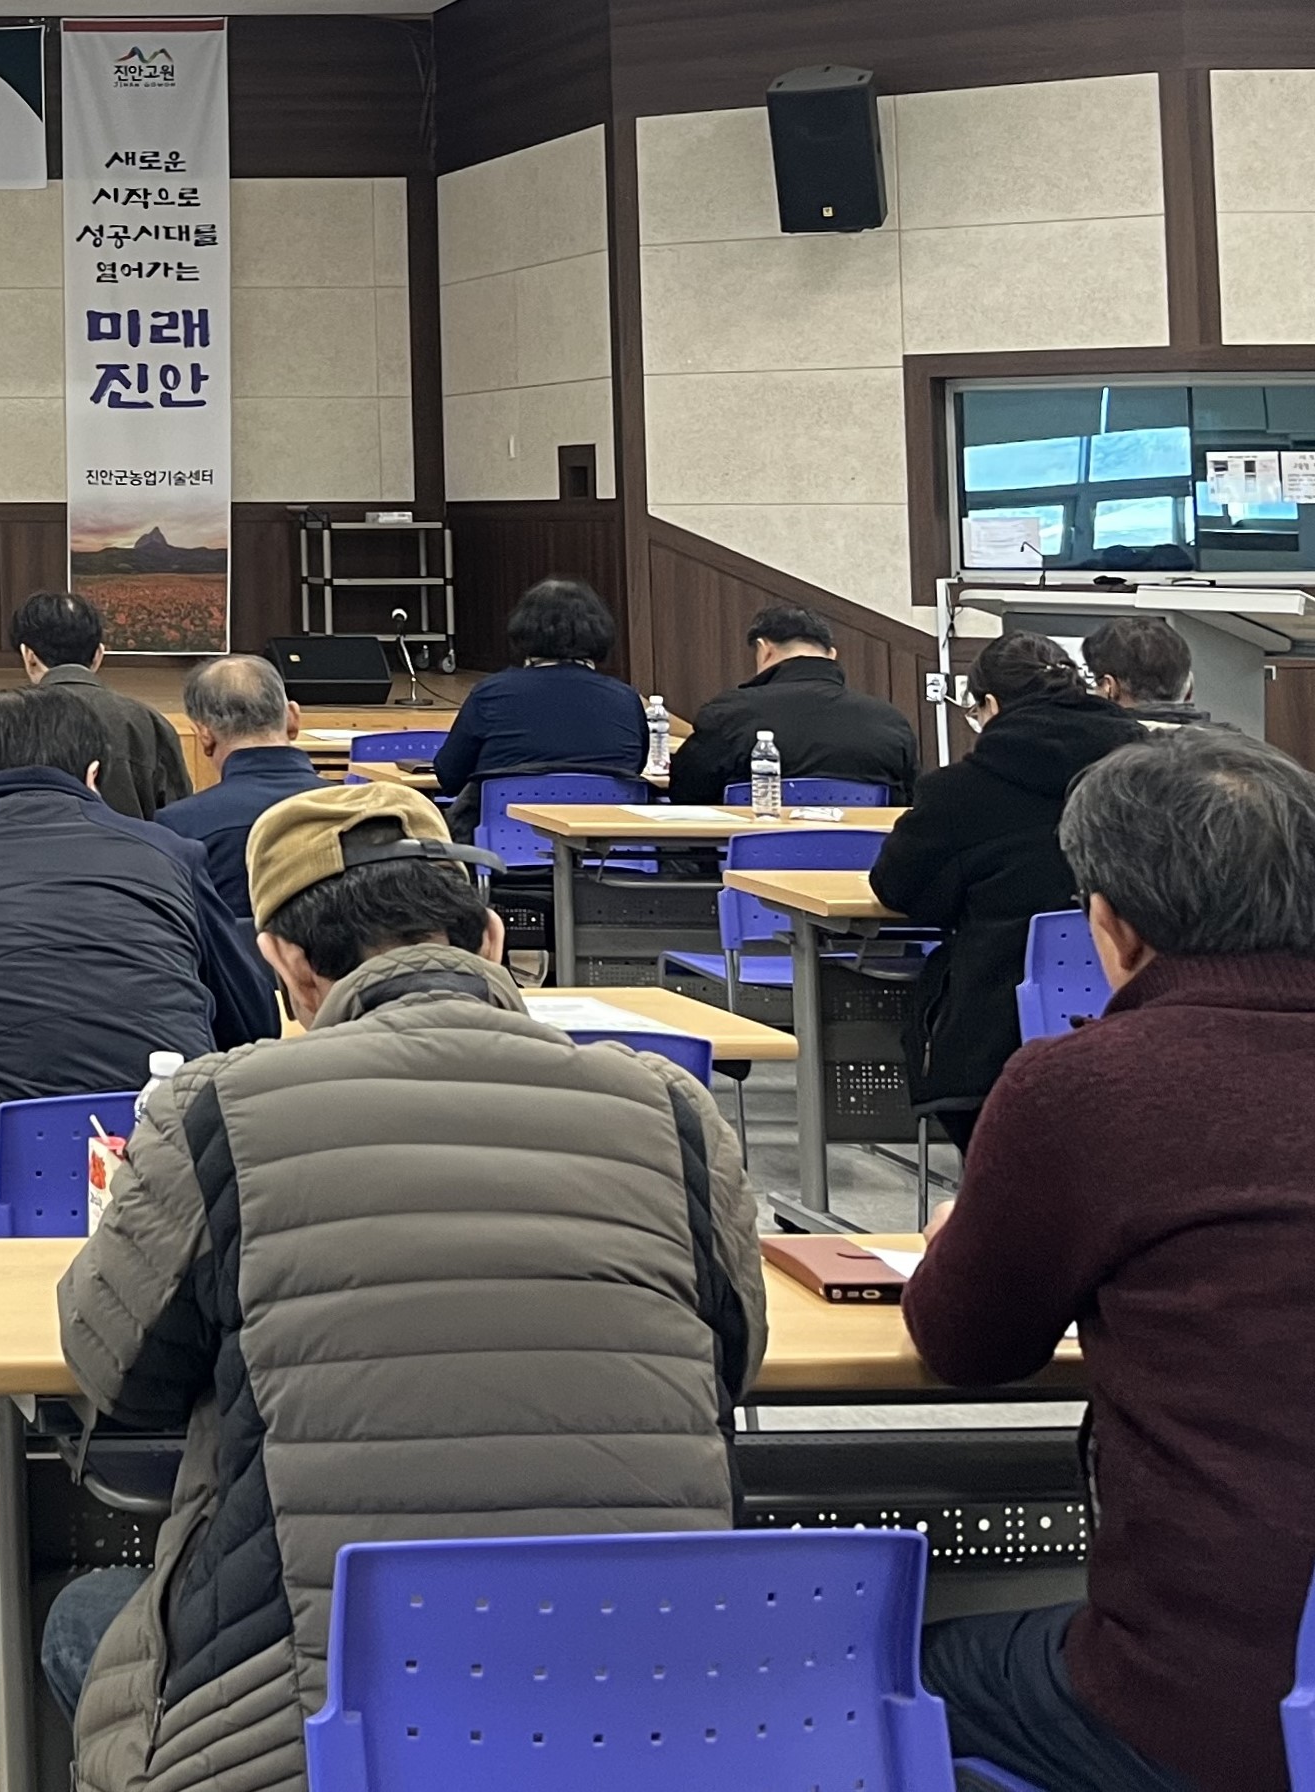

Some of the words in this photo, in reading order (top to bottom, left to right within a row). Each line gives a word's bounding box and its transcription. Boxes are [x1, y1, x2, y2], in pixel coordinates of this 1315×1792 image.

[113, 64, 175, 82] 진안고원
[104, 149, 188, 174] 새로운
[91, 187, 202, 210] 시작으로
[75, 223, 220, 250] 성공시대를
[95, 260, 201, 285] 열어가는
[85, 308, 211, 350] 미래
[89, 361, 211, 410] 진안
[84, 467, 214, 487] 진안군농업기술센터
